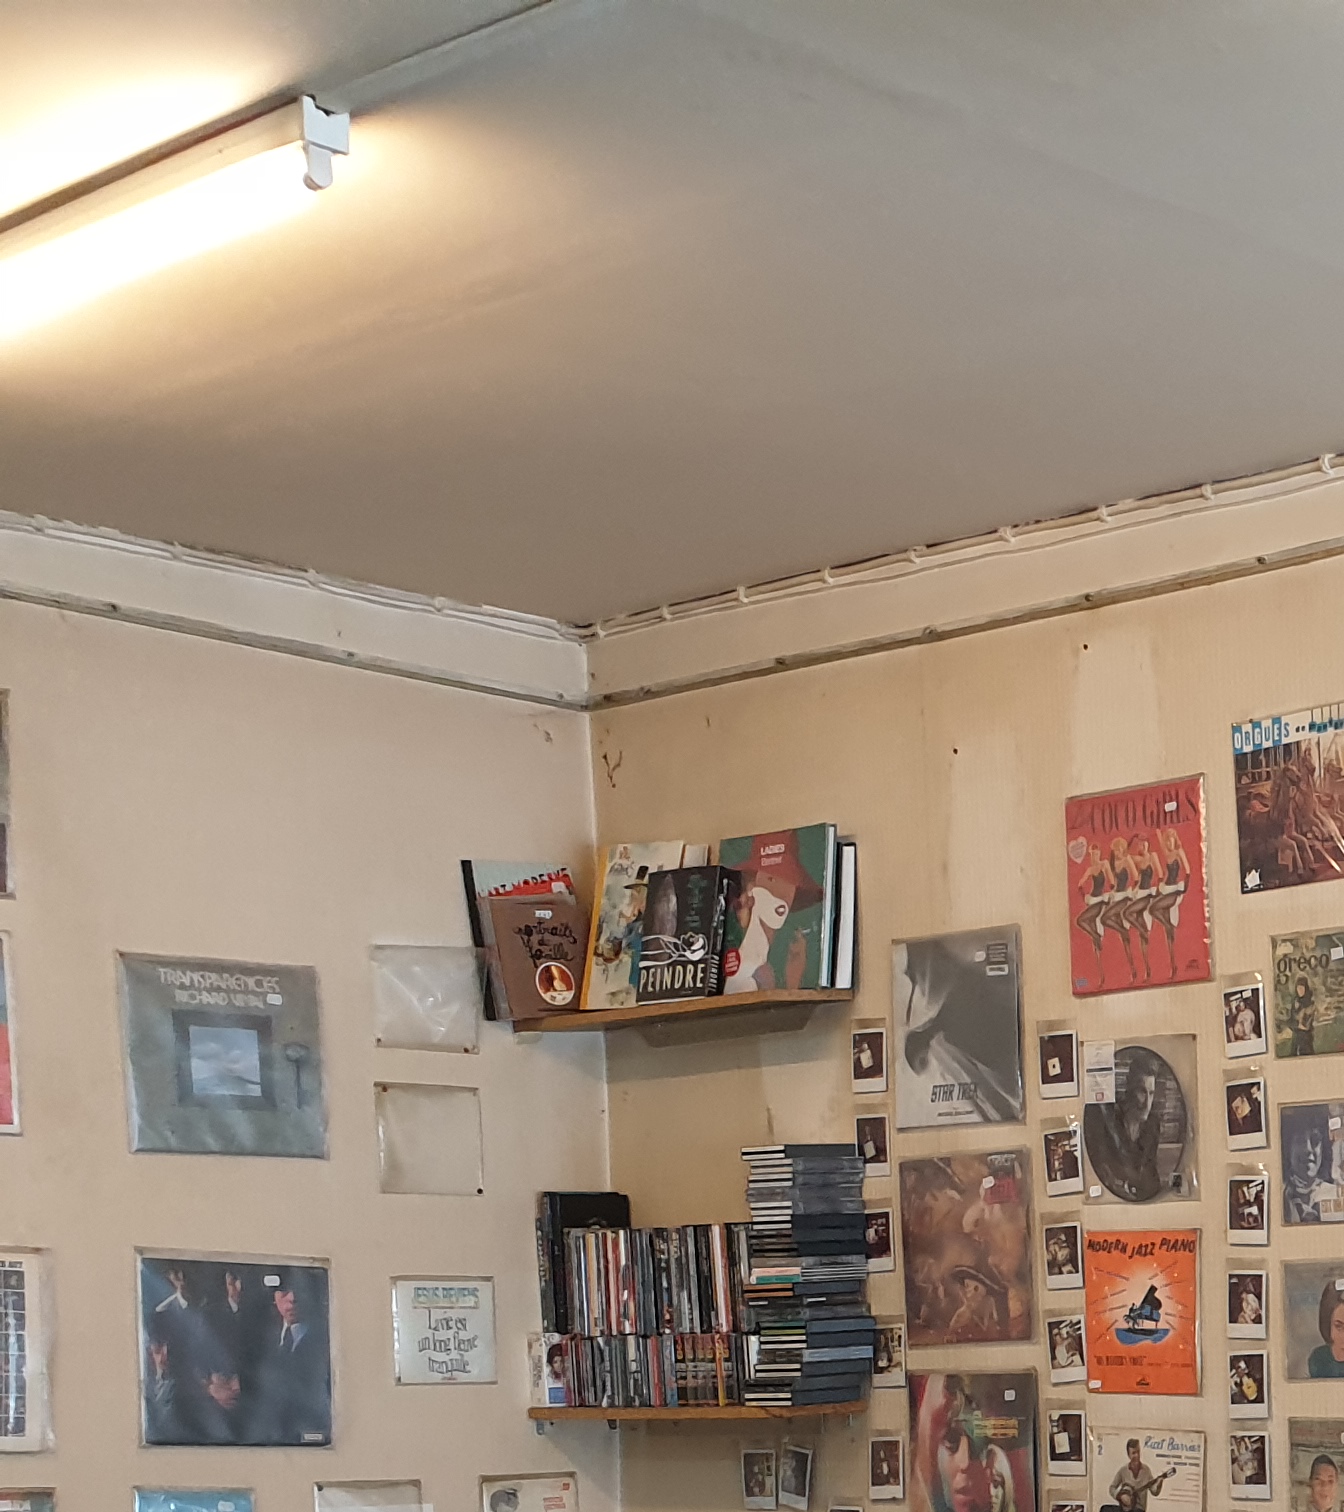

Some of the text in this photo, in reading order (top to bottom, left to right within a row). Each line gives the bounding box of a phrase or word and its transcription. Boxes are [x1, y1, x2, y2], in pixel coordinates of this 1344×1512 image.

[639, 962, 706, 994] PEINDRE
[1276, 952, 1330, 986] greco
[930, 1083, 956, 1103] STAR
[1158, 1237, 1197, 1254] PIANO
